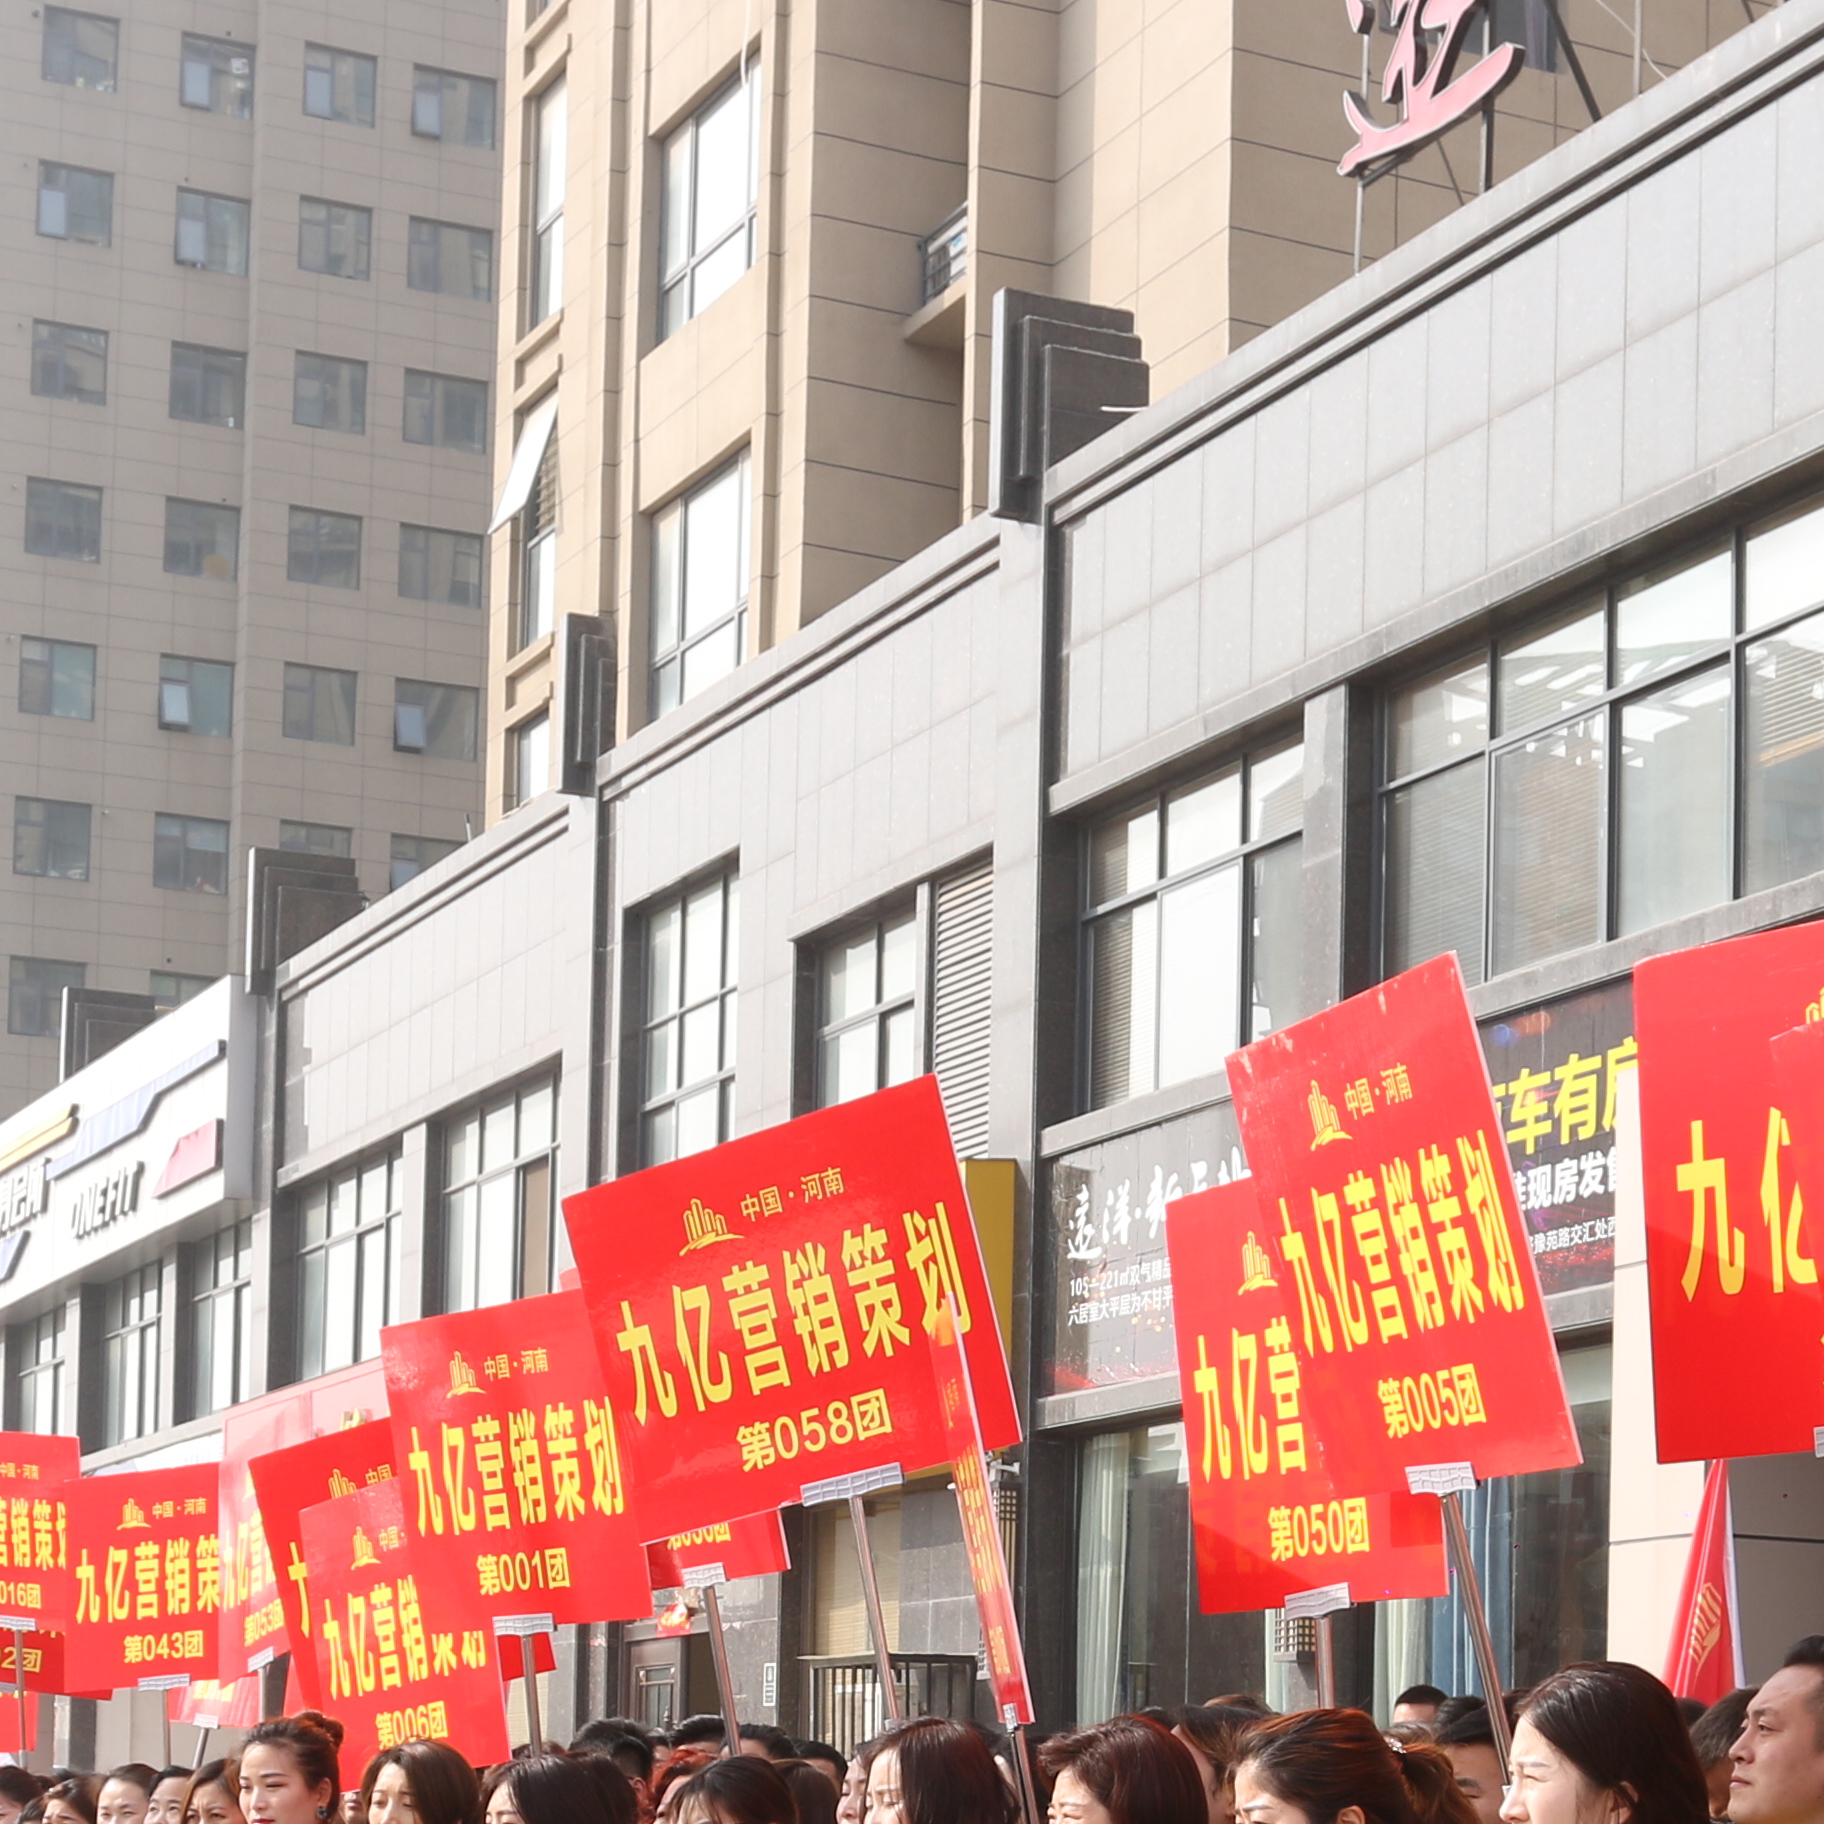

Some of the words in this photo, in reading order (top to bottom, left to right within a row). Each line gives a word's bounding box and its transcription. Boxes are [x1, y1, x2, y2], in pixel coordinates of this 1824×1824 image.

[1281, 1130, 1524, 1357] 九亿营销策划
[617, 1202, 972, 1427] 九亿营销策划
[736, 1389, 892, 1472] 第058团
[1378, 1362, 1486, 1439] 第005团
[408, 1396, 624, 1537] 九亿营销策划
[1268, 1496, 1370, 1561] 第050团
[476, 1548, 571, 1596] 第001团
[123, 1630, 204, 1663] 第043团
[244, 1598, 284, 1647] 第053团
[375, 1701, 448, 1751] 第006团
